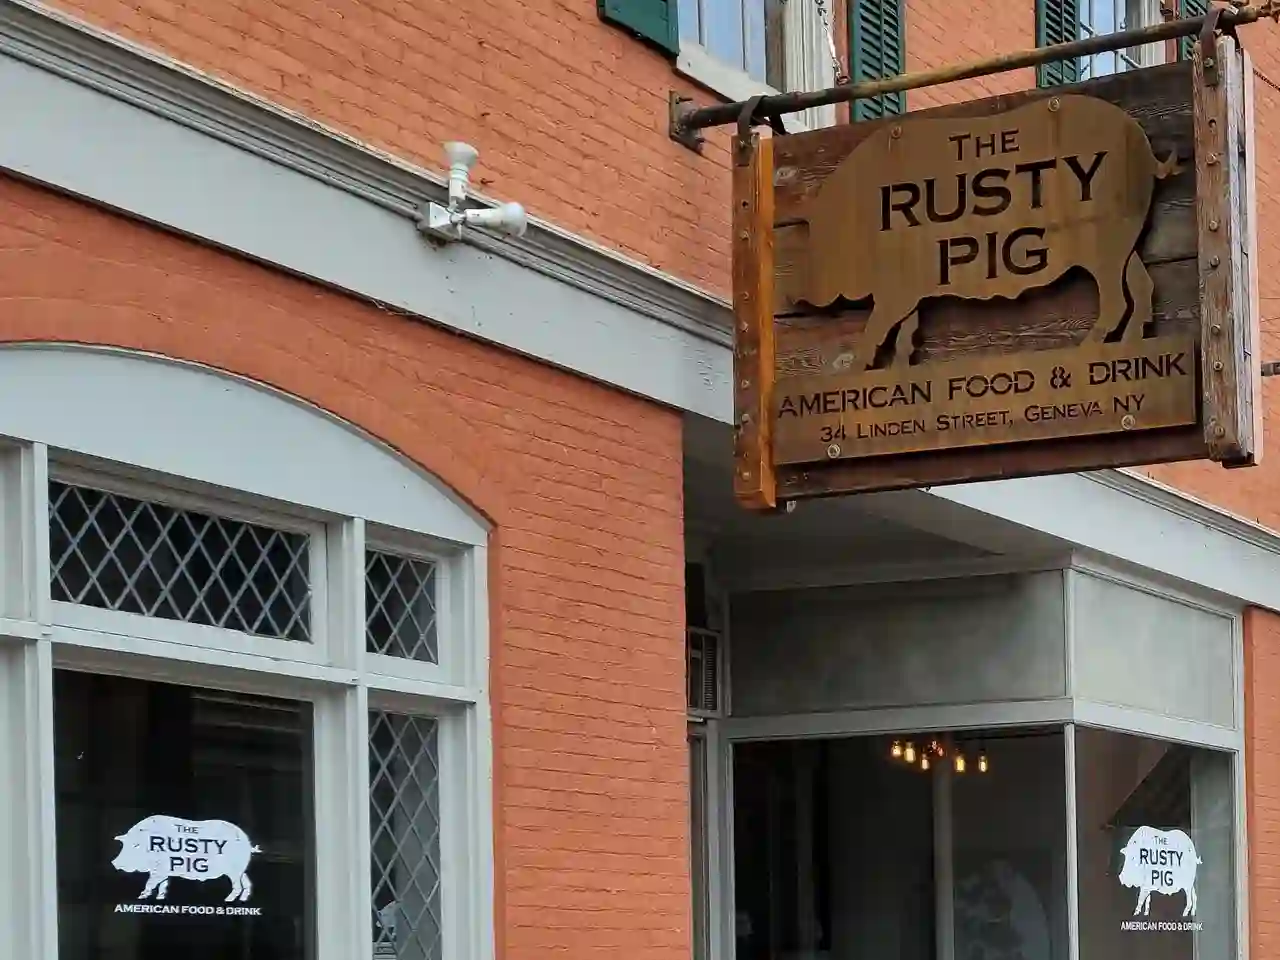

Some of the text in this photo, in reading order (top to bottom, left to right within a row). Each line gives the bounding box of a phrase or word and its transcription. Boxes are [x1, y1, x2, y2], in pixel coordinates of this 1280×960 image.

[948, 128, 1020, 162] THE
[879, 151, 1108, 232] RUSTY
[937, 227, 1050, 285] PIG
[777, 352, 1187, 419] AMERICAN FOOD & DRINK
[820, 422, 847, 443] 34
[856, 418, 926, 441] LINDEN
[1024, 401, 1103, 424] GENEVA
[1113, 393, 1145, 415] NY
[174, 824, 199, 834] THE
[149, 836, 228, 855] RUSTY
[1154, 836, 1168, 845] THE
[169, 857, 209, 872] PIG
[1139, 848, 1184, 867] RUSTY
[1151, 870, 1174, 887] PIG
[114, 904, 262, 916] AMERICAN FOOD & DRINK
[1120, 921, 1203, 931] AMERICAN FOOD & DRINK
